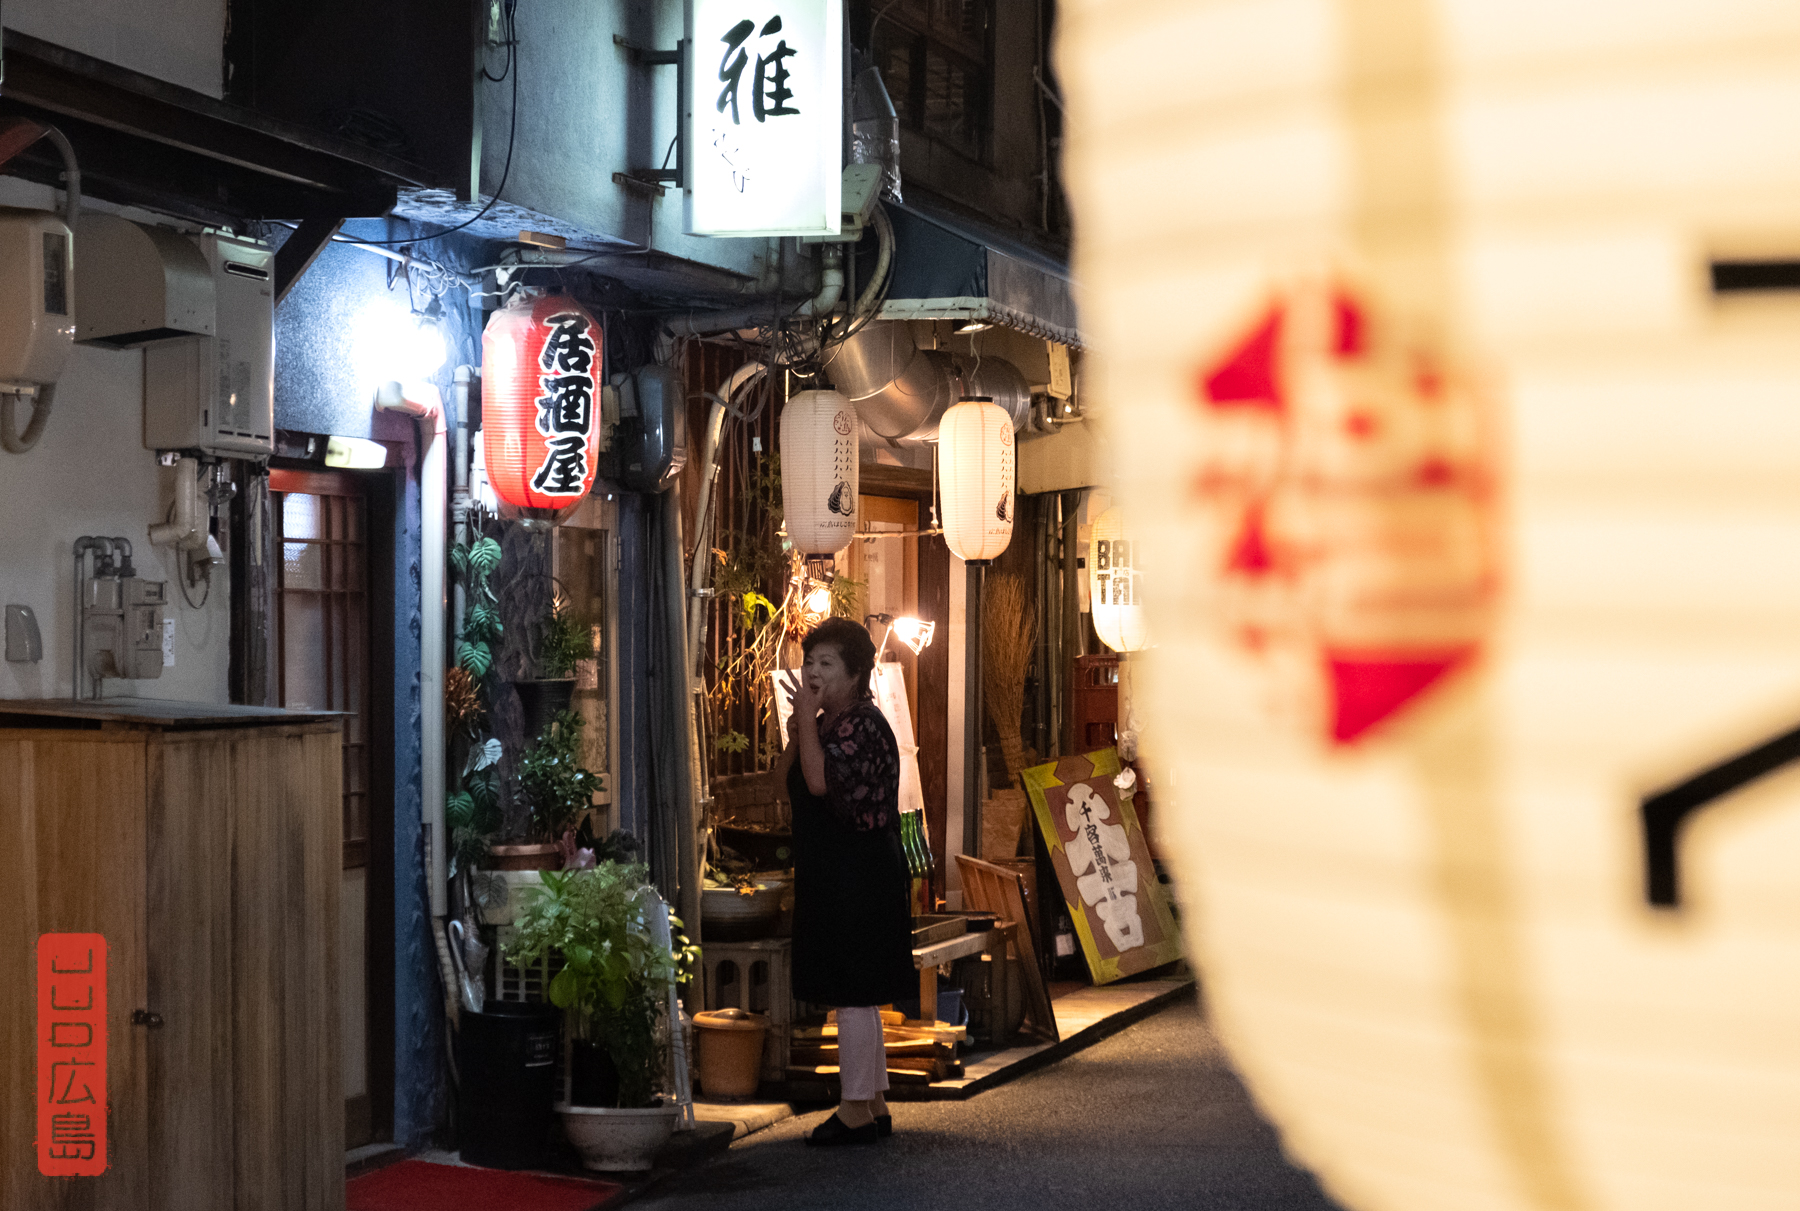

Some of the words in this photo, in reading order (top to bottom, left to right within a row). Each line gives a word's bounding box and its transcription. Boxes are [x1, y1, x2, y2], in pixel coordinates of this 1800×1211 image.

[716, 14, 801, 125] 雅
[533, 313, 595, 495] 居酒屋
